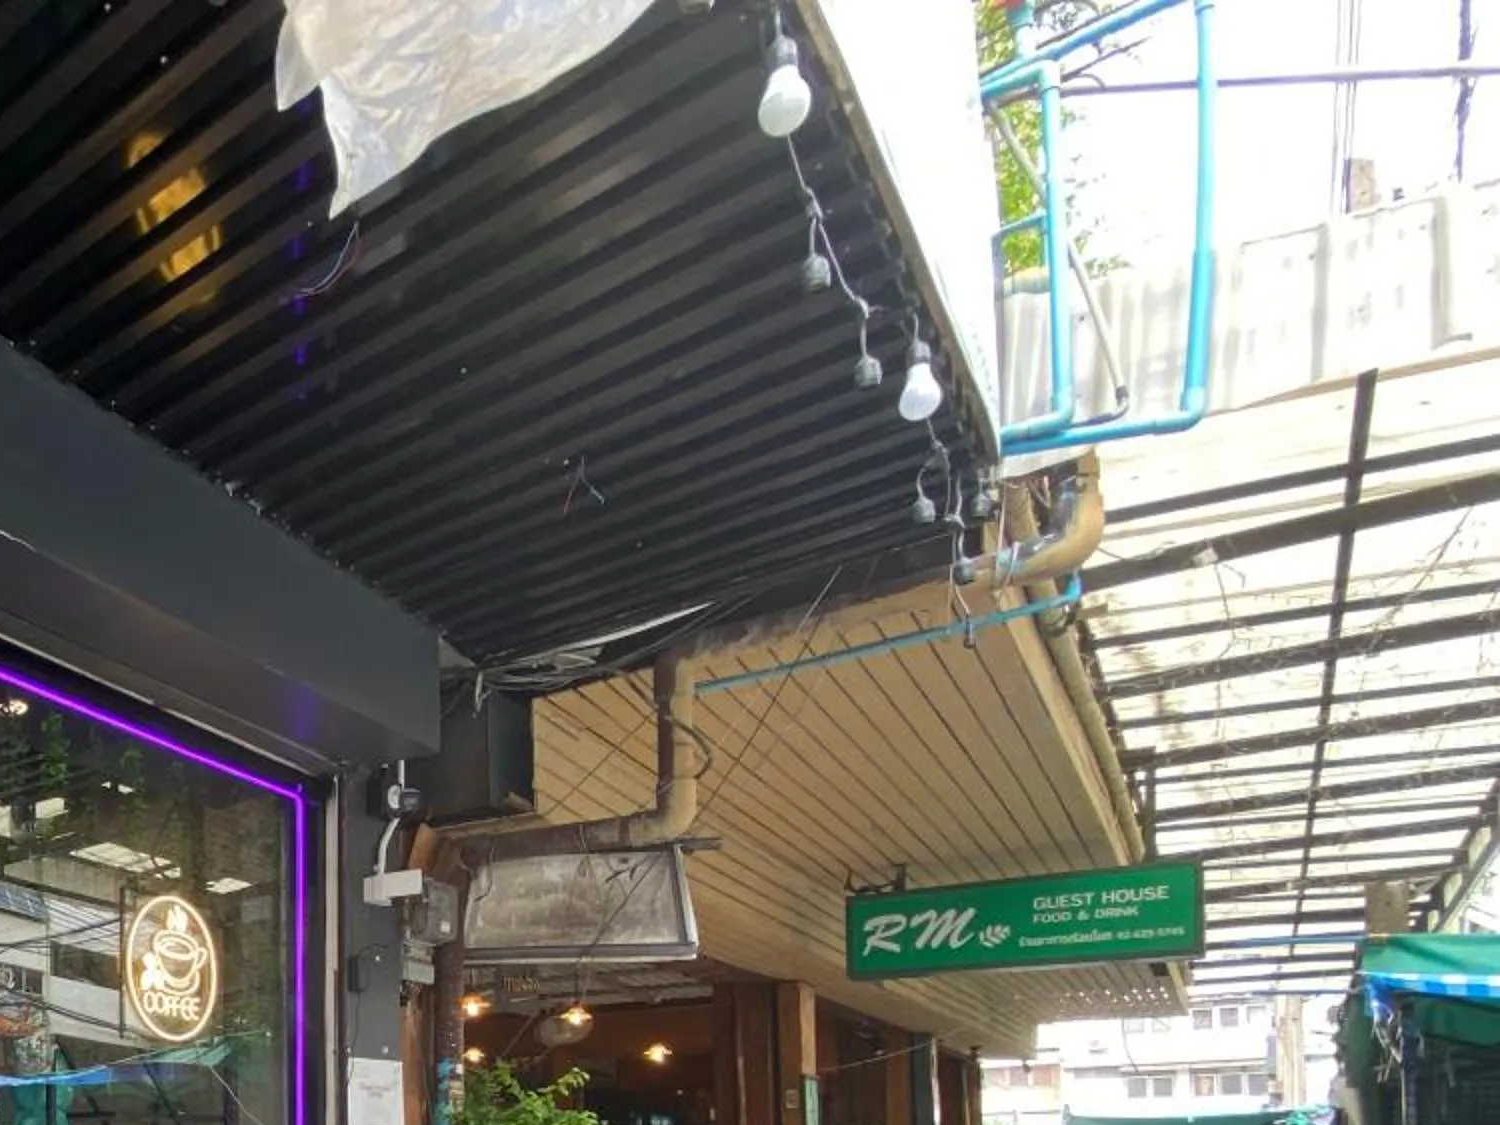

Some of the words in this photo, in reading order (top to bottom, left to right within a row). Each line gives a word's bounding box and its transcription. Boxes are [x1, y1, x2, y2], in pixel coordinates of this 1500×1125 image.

[1032, 892, 1095, 911] GUEST
[1101, 885, 1171, 904] HOUSE
[1032, 911, 1072, 925] FOOD
[1076, 911, 1090, 921] &
[1094, 905, 1140, 919] DRINK
[861, 907, 976, 957] RM
[143, 990, 202, 1021] COFFEE
